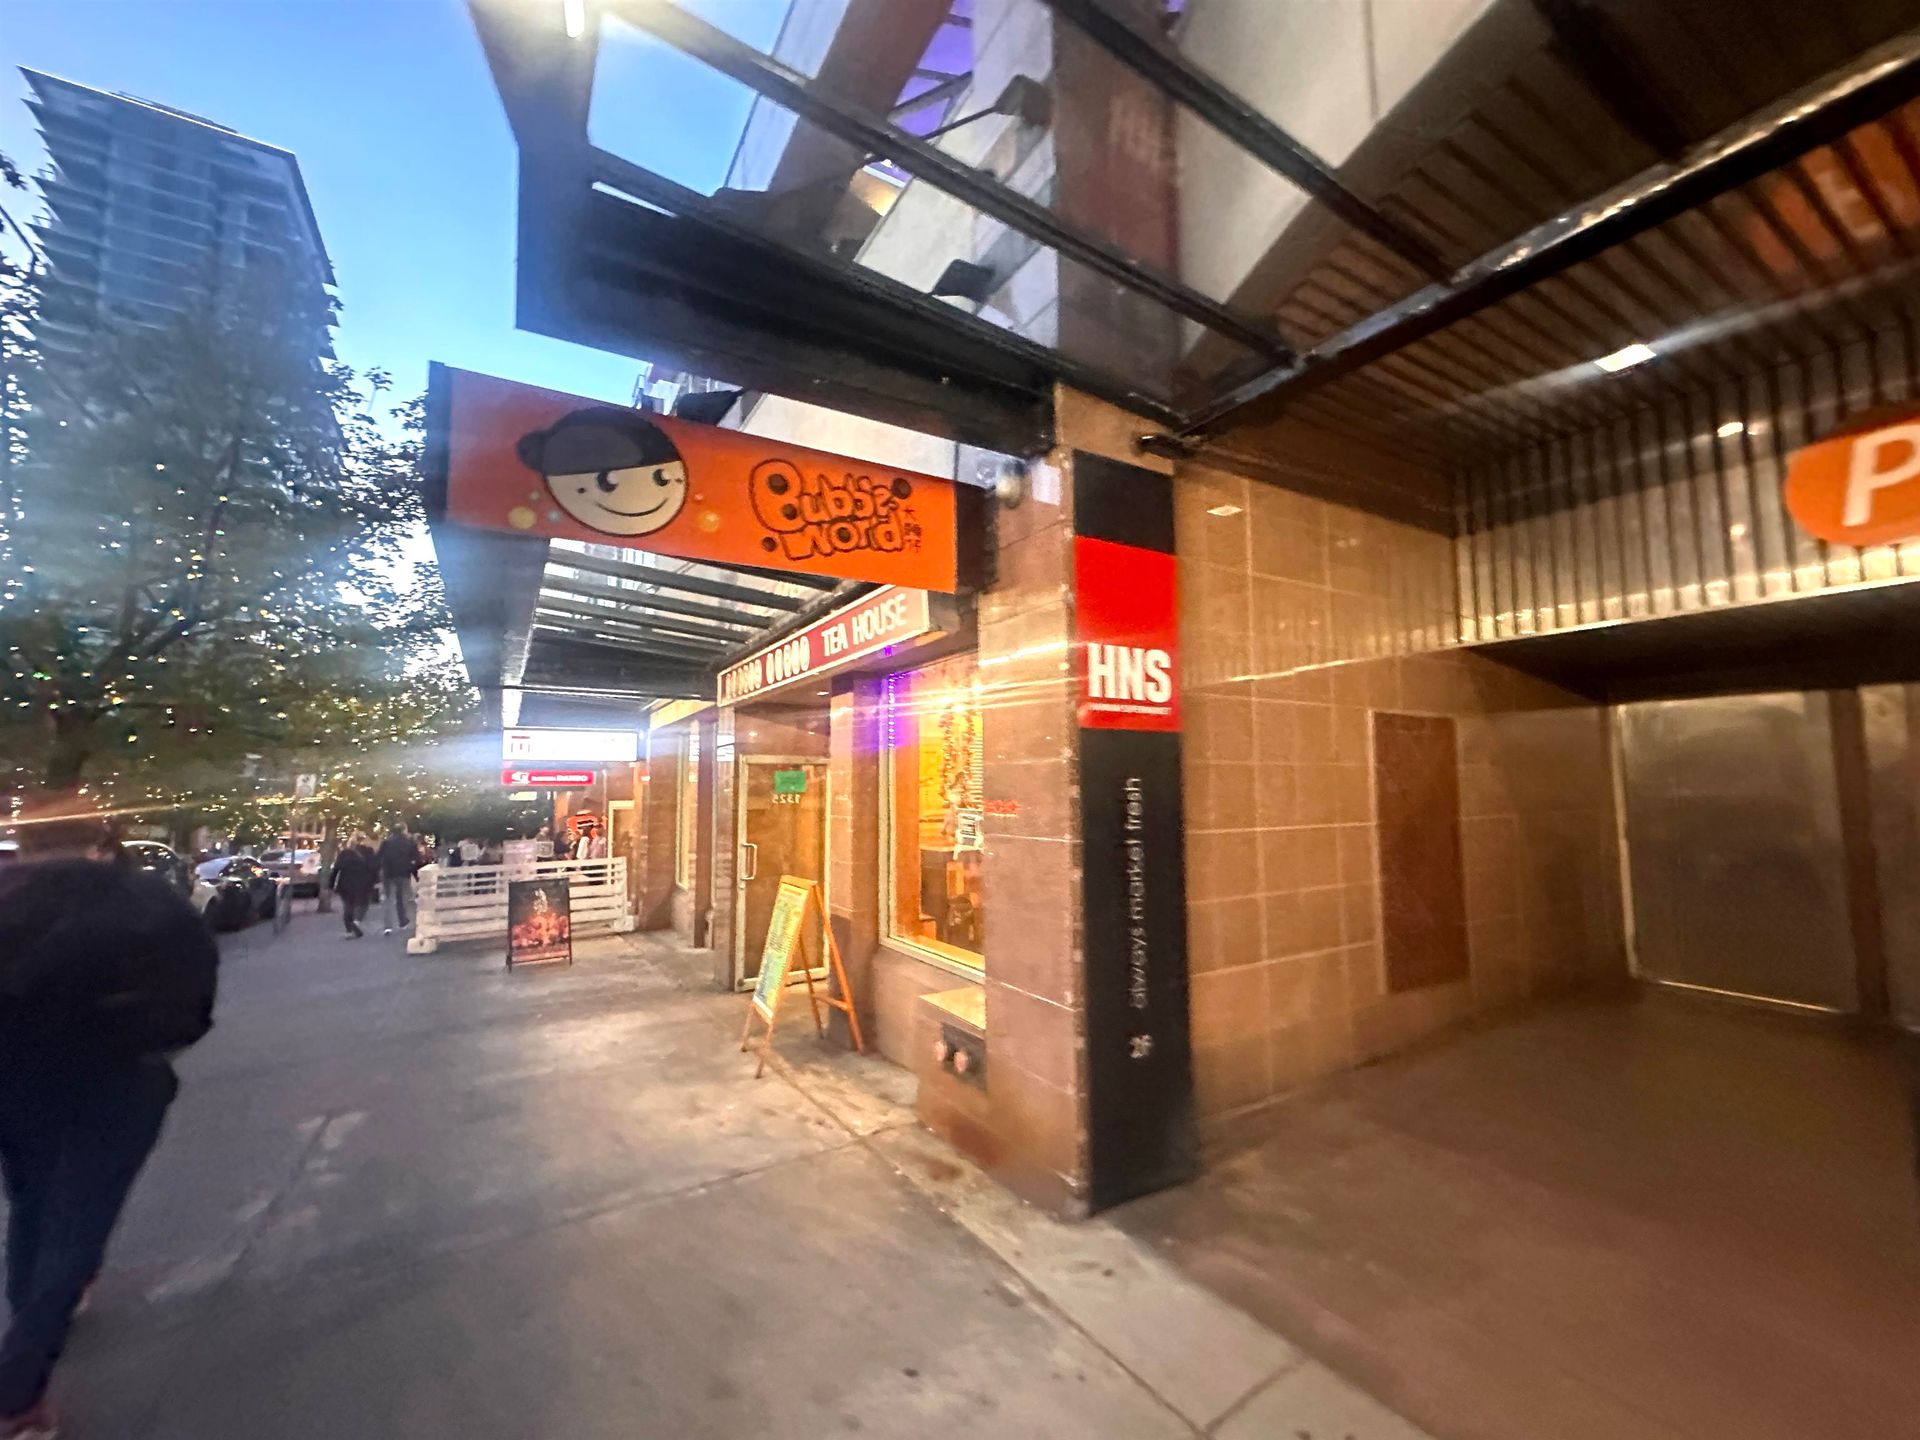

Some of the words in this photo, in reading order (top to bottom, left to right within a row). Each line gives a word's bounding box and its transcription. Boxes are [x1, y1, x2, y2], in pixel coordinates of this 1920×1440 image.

[821, 623, 849, 656] TEA
[852, 593, 908, 645] HOUSE
[1087, 642, 1173, 703] HNS
[1122, 776, 1143, 831] fresh
[1124, 839, 1145, 920] market
[1128, 926, 1149, 1009] always
